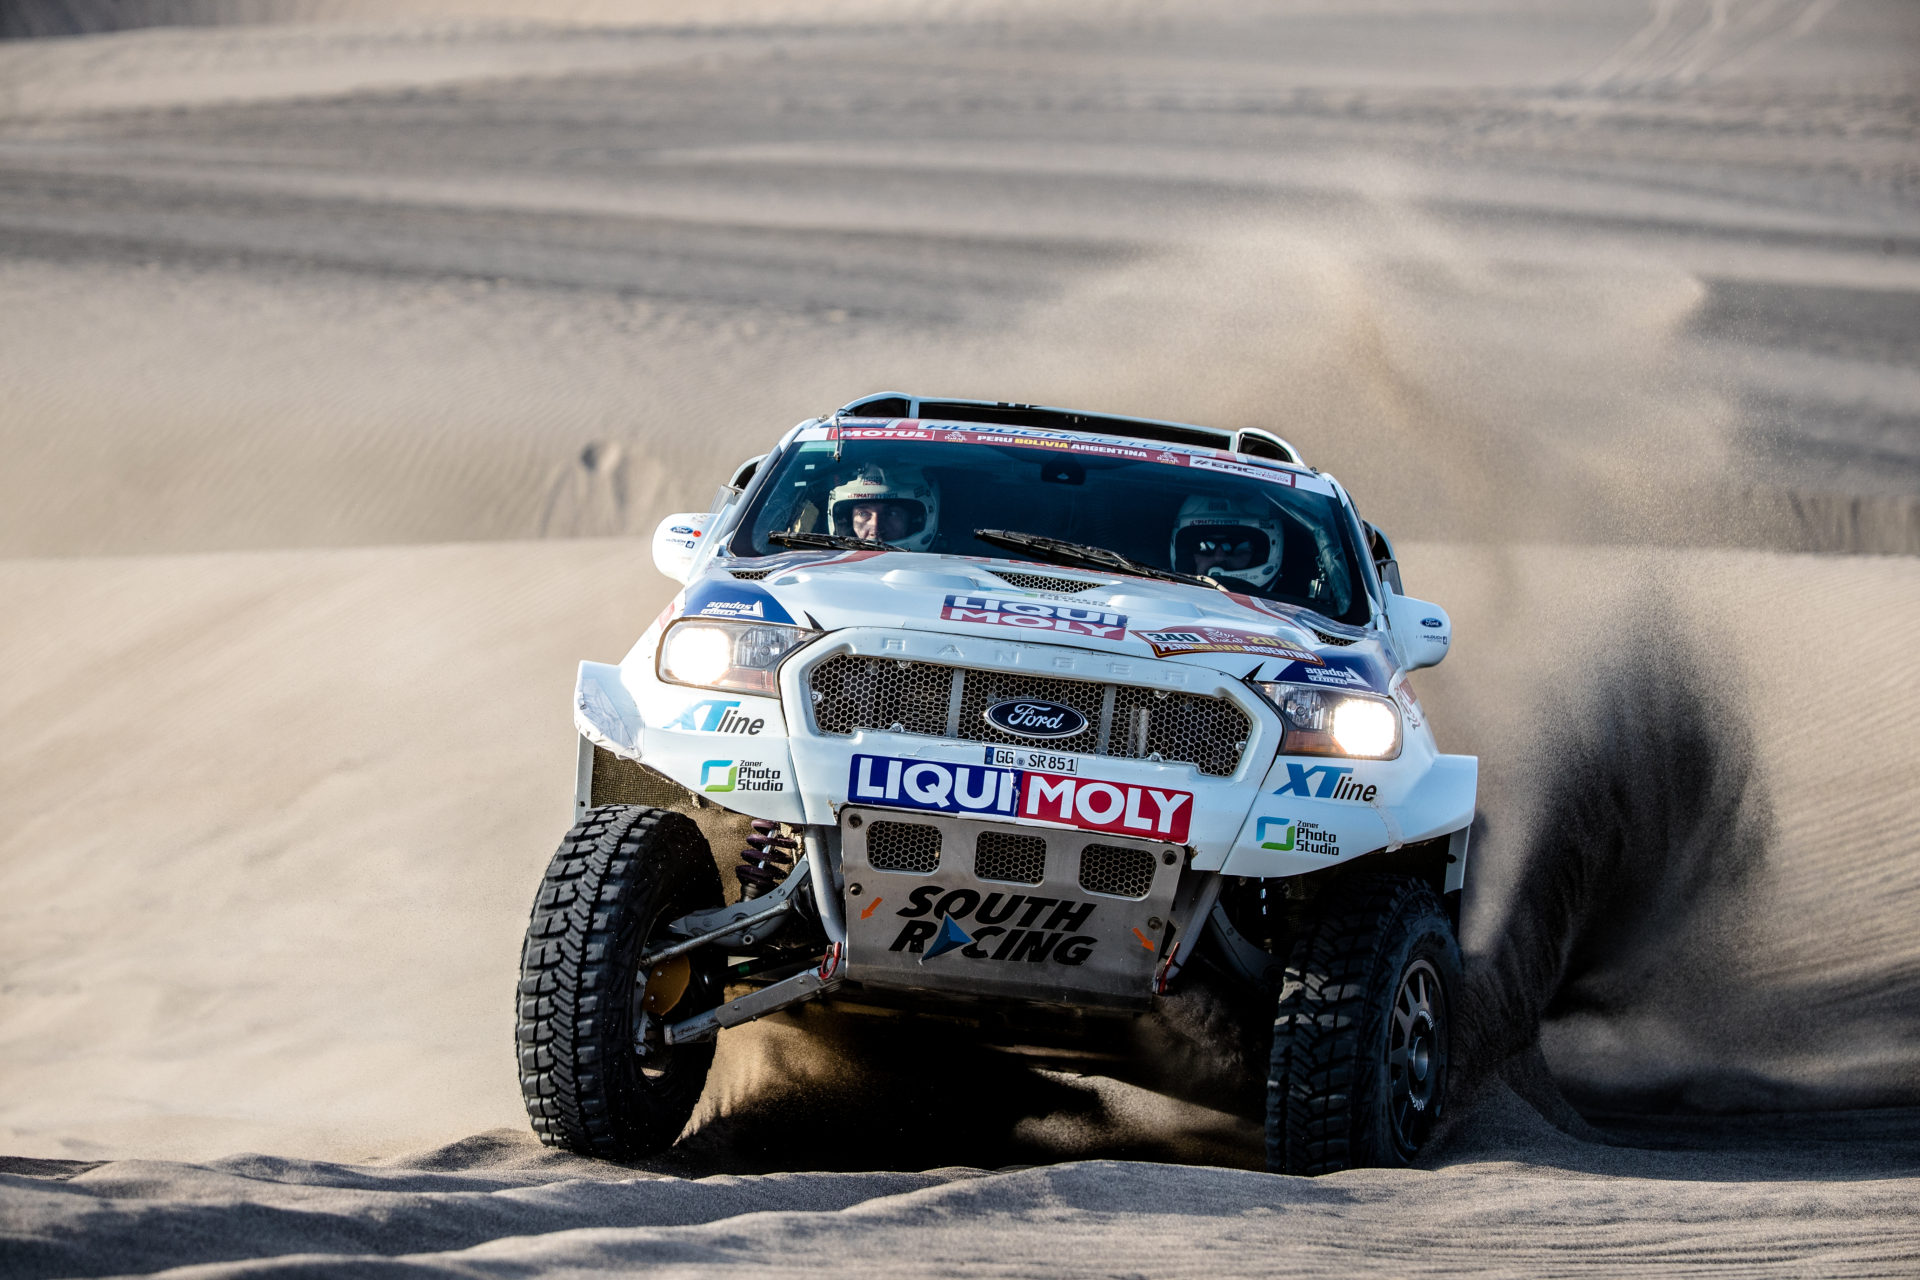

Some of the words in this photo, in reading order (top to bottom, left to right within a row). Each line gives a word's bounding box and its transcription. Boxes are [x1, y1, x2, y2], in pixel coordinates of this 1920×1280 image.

[977, 435, 1013, 443] PERU
[1014, 438, 1069, 449] BOLIVIA
[1071, 443, 1148, 458] ARGENTINA
[706, 601, 753, 610] agados
[953, 597, 1118, 626] LIQUI
[950, 608, 1122, 637] MOLY
[1147, 633, 1201, 643] 340
[1246, 636, 1303, 652] 2018
[1159, 642, 1193, 652] PERU
[1243, 645, 1318, 661] ARGENTINA
[1305, 667, 1351, 678] agados
[662, 699, 765, 736] XTline
[1007, 703, 1065, 729] Ford
[996, 750, 1014, 764] GG
[738, 767, 781, 779] Photo
[737, 779, 783, 791] Studio
[1272, 763, 1377, 801] XTline
[857, 757, 1015, 808] LIQUI
[1026, 775, 1190, 834] MOLY
[1297, 820, 1319, 828] Zoner
[1296, 827, 1337, 843] Photo
[1296, 840, 1340, 856] Studio
[895, 885, 1098, 932] SOUTH
